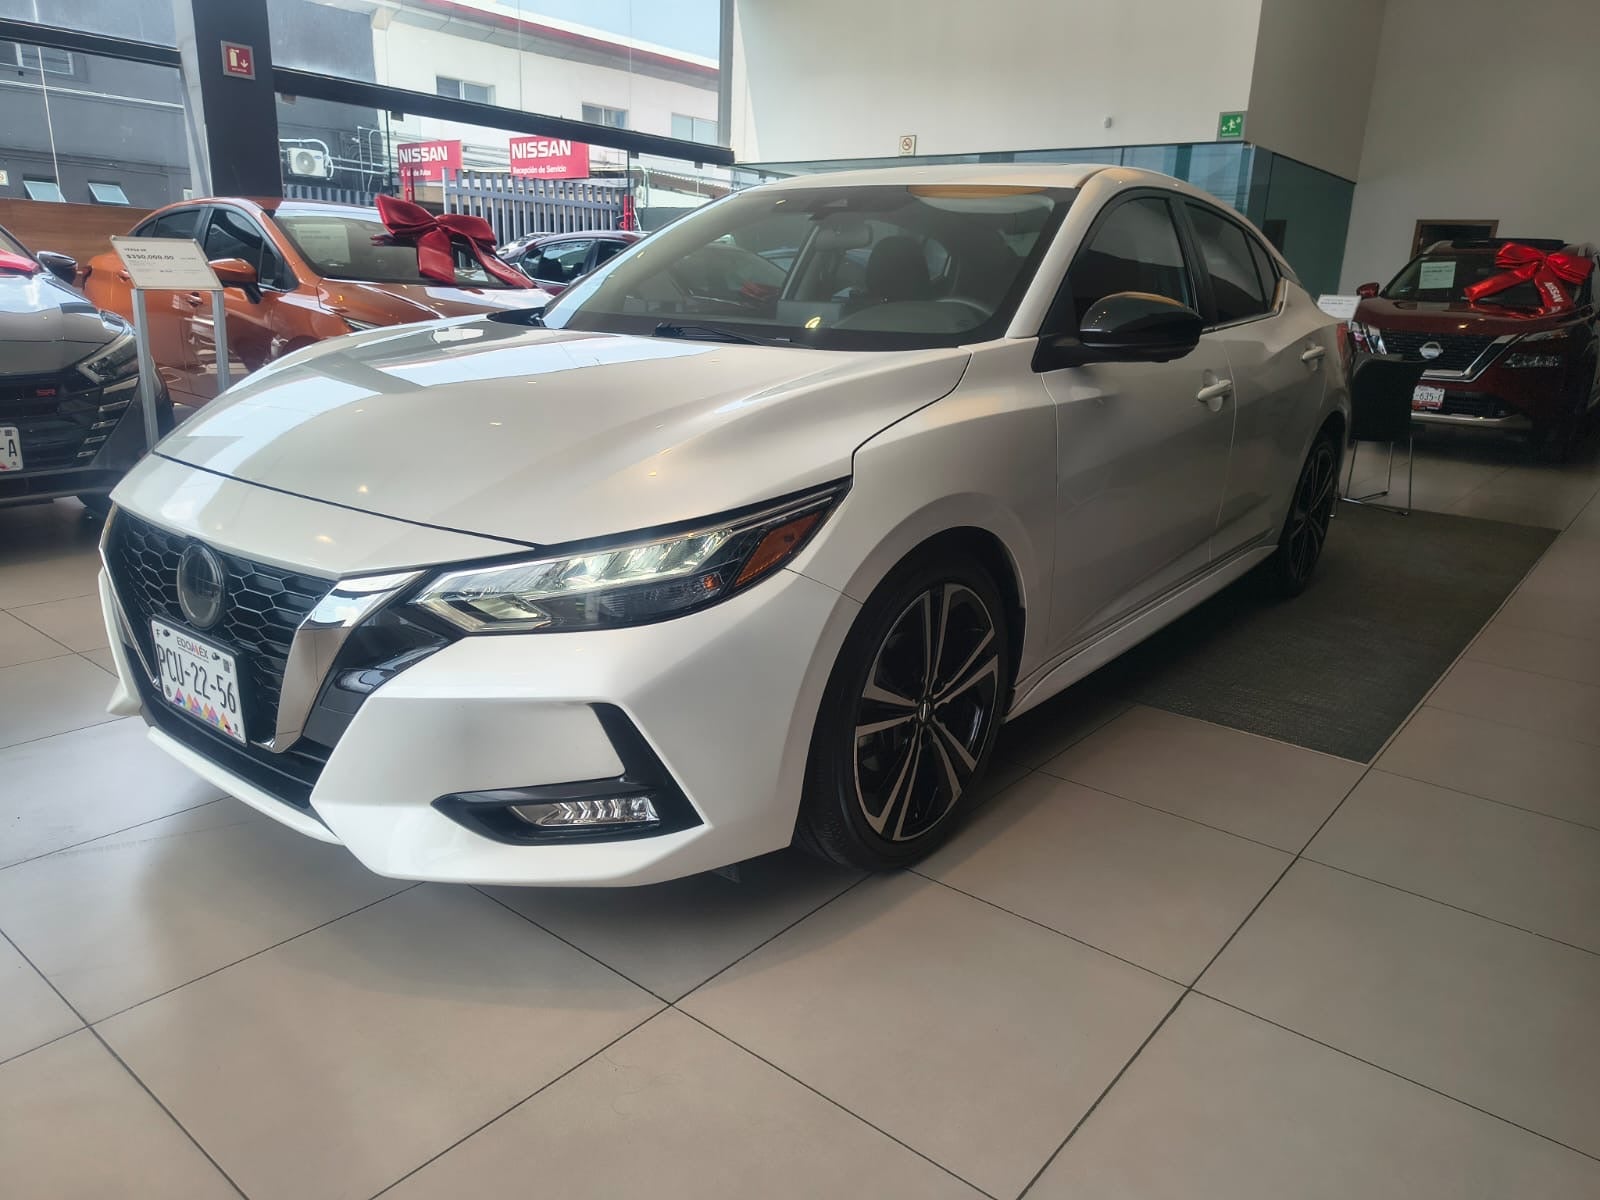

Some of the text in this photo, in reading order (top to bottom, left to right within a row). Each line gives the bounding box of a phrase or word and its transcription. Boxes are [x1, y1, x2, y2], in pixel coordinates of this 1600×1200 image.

[399, 146, 448, 163] NISSAN
[511, 140, 571, 159] NISSAN
[546, 164, 567, 173] Servicio
